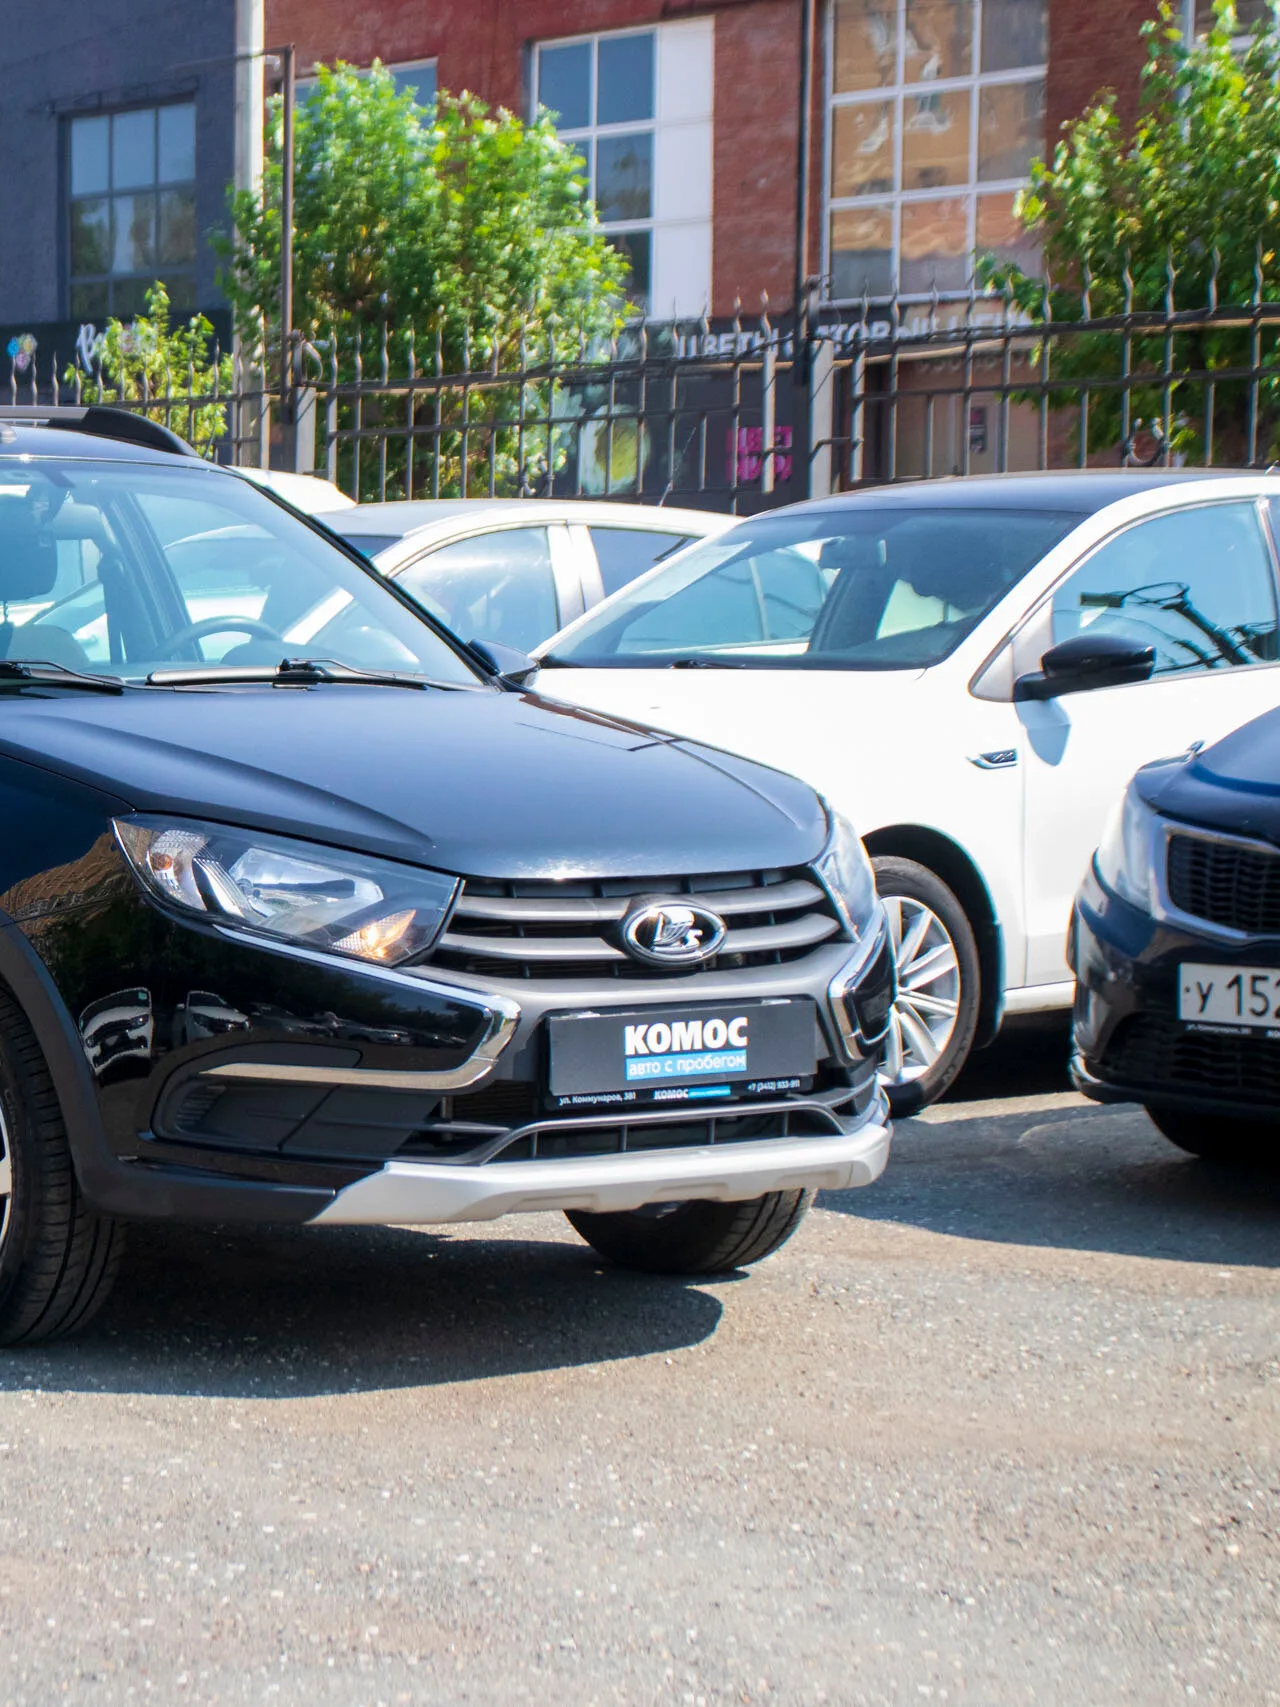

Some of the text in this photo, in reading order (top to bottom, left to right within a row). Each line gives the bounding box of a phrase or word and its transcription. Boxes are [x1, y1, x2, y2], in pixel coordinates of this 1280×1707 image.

[624, 1016, 748, 1056] КОМОС
[629, 1053, 747, 1077] авто с пробегом
[559, 1096, 571, 1106] ул.
[654, 1088, 689, 1100] КОМОС
